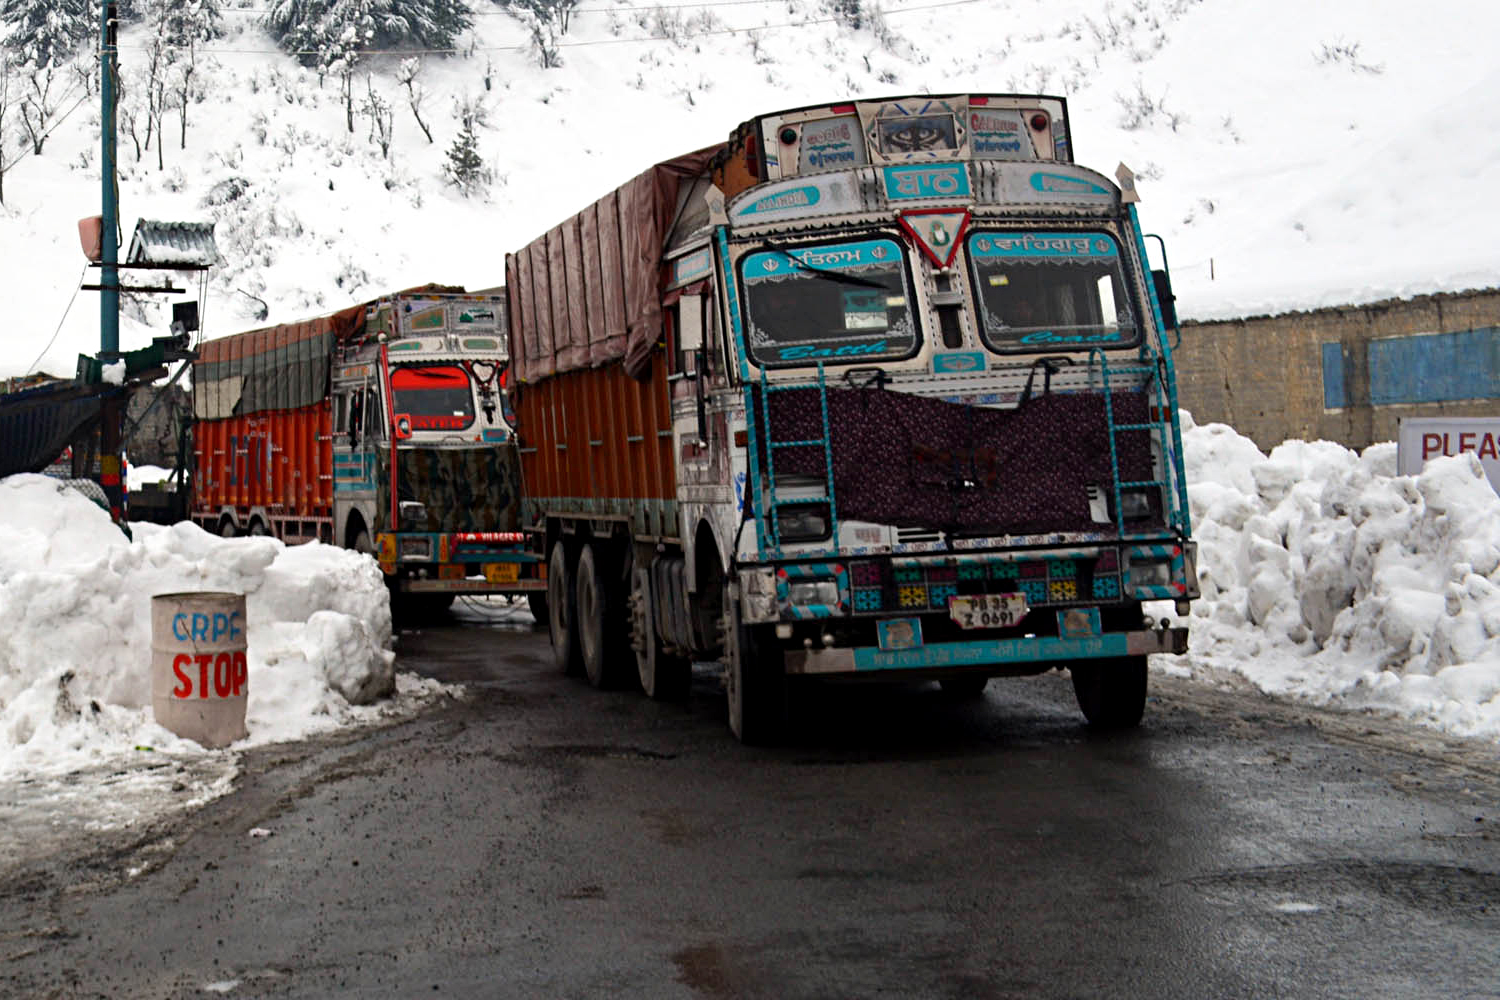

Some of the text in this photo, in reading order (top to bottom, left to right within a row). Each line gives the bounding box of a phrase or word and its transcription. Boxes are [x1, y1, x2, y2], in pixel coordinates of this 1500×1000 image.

[1020, 329, 1121, 345] Coach
[1422, 432, 1500, 461] PLEA
[172, 611, 242, 643] CRPF
[963, 611, 1014, 627] Z 0691
[172, 651, 247, 699] STOP
